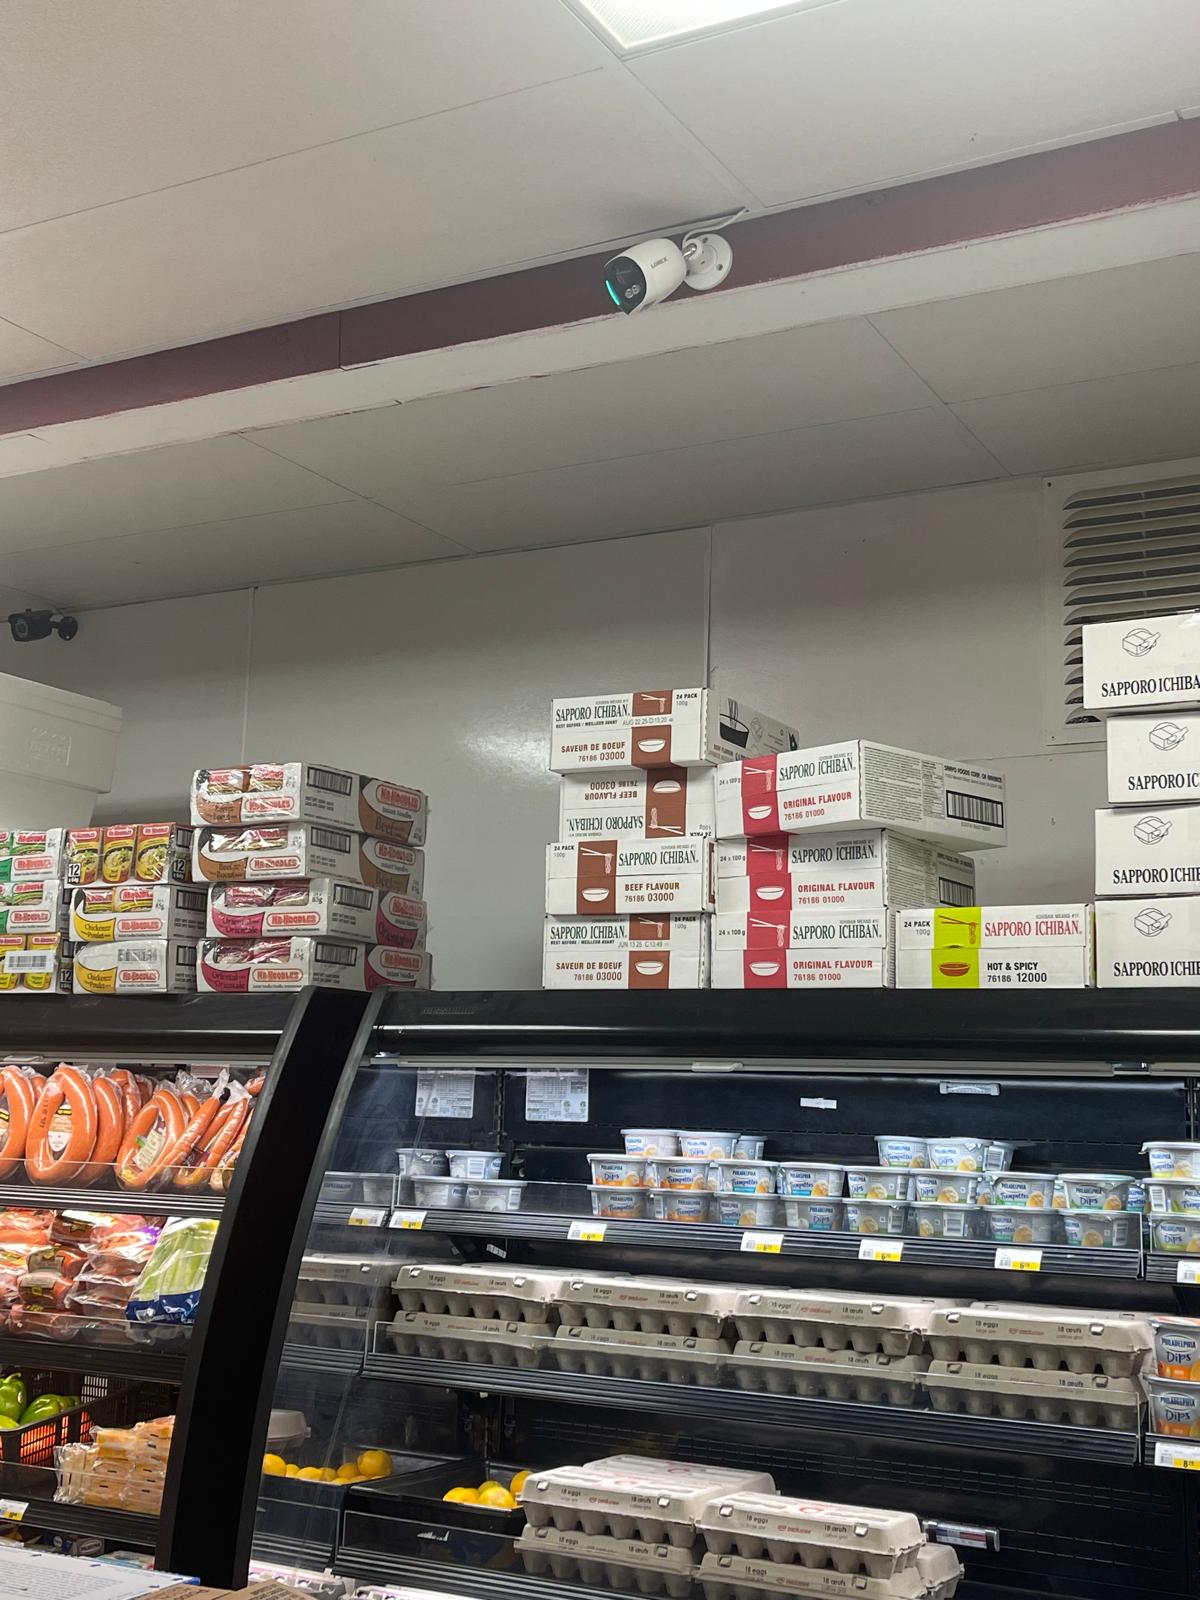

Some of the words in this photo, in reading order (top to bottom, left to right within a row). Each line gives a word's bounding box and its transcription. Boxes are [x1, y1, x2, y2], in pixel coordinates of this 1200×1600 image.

[1101, 678, 1157, 698] SAPPORO
[555, 706, 592, 723] SAPPORO
[560, 744, 588, 754] SAVEUR
[590, 743, 600, 752] DE
[602, 741, 626, 751] BOEUF
[578, 754, 598, 763] 76186
[599, 750, 626, 761] 03000
[779, 762, 815, 782] SAPPORO
[590, 781, 616, 791] 03000
[1127, 773, 1186, 791] SAPPORO
[584, 792, 617, 800] FLAVOUR
[618, 791, 638, 799] BEEF
[783, 797, 817, 810] ORIGINAL
[818, 792, 852, 805] FLAVOUR
[783, 811, 803, 821] 76186
[805, 809, 825, 819] 01000
[606, 815, 644, 830] SAPPORO
[618, 851, 657, 867] SAPPORO
[791, 848, 833, 864] SAPPORO
[70, 864, 80, 876] 12
[174, 859, 186, 872] 12
[1113, 867, 1168, 885] SAPPORO
[625, 884, 644, 892] BEEF
[646, 882, 680, 891] FLAVOUR
[798, 884, 836, 893] ORIGINAL
[838, 882, 875, 891] FLAVOUR
[624, 895, 645, 903] 76186
[647, 892, 675, 902] 03000
[798, 896, 820, 905] 76186
[822, 896, 845, 904] 01000
[84, 923, 104, 931] Chicken
[914, 920, 931, 928] PACK
[984, 921, 1031, 937] SAPPORO
[550, 925, 587, 940] SAPPORO
[792, 925, 835, 940] SAPPORO
[916, 929, 931, 937] 100g
[555, 961, 584, 970] SAVEUR
[586, 961, 596, 970] DE
[598, 961, 623, 970] BOEUF
[793, 961, 832, 970] ORIGINAL
[834, 960, 873, 969] FLAVOUR
[986, 962, 1004, 971] HOT
[1005, 962, 1012, 971] &
[1014, 962, 1039, 972] SPICY
[1113, 961, 1169, 978] SAPPORO
[62, 969, 72, 983] 12
[87, 973, 105, 981] Chicken
[596, 971, 622, 981] 03000
[793, 973, 816, 981] 76186
[818, 973, 842, 981] 01000
[986, 974, 1012, 983] 76186
[1016, 972, 1047, 983] 12000
[1080, 1196, 1098, 1205] Dips
[813, 1215, 830, 1224] Dips
[983, 1320, 999, 1329] eggs
[1161, 1336, 1197, 1350] PHILADELPHIA
[1166, 1351, 1192, 1364] Dips
[1160, 1395, 1196, 1408] PHILADELPHIA
[1165, 1409, 1191, 1422] Dips
[746, 1513, 753, 1521] 18
[753, 1515, 768, 1525] eggs
[824, 1523, 831, 1532] 18
[745, 1565, 751, 1573] 18
[752, 1566, 767, 1576] eggs
[823, 1576, 830, 1584] 18
